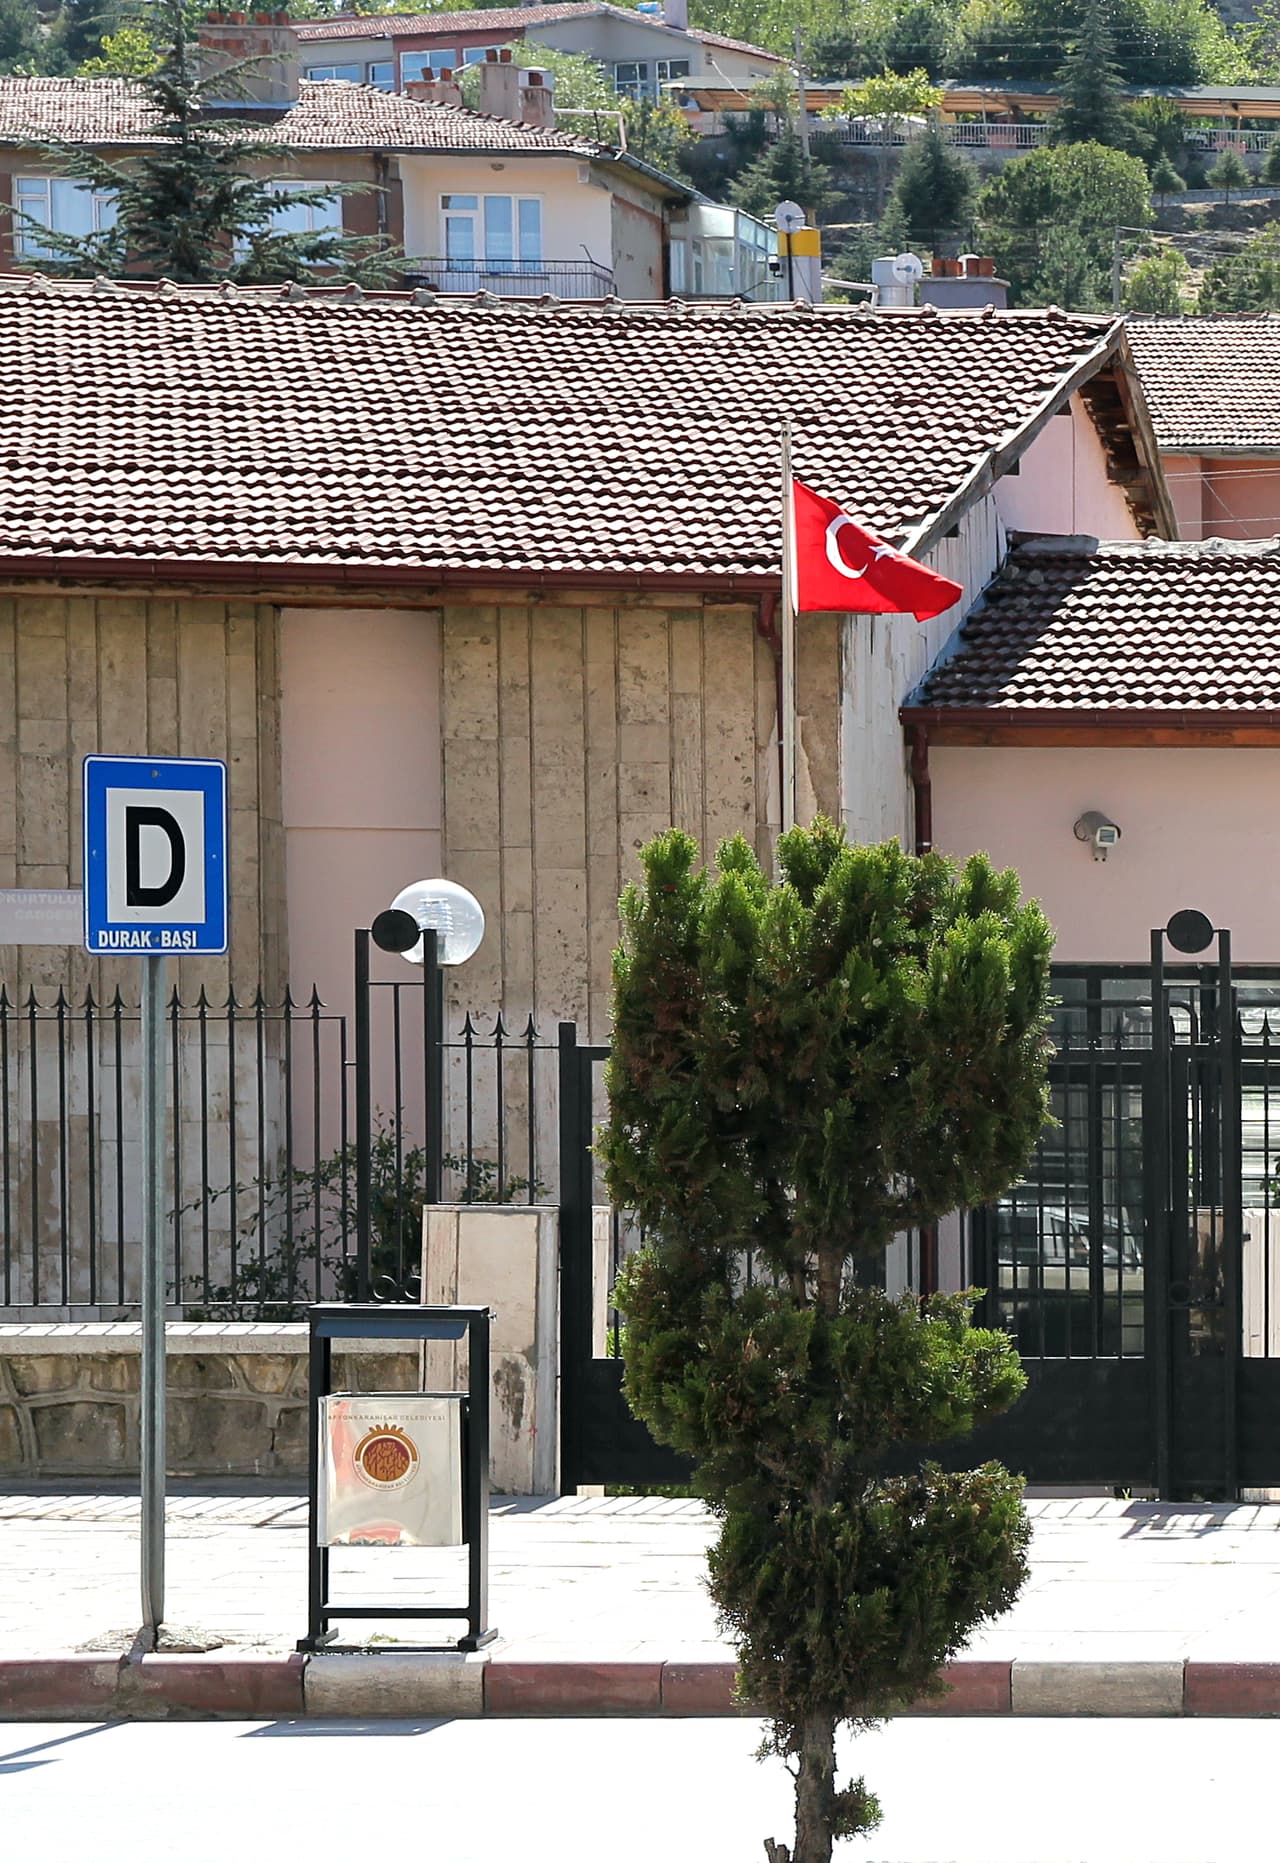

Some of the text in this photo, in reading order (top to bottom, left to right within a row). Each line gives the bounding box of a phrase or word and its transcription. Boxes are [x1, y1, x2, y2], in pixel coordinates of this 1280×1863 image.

[126, 806, 186, 908] D
[6, 893, 82, 905] KURTULU
[98, 930, 198, 950] DURAK BAŞI
